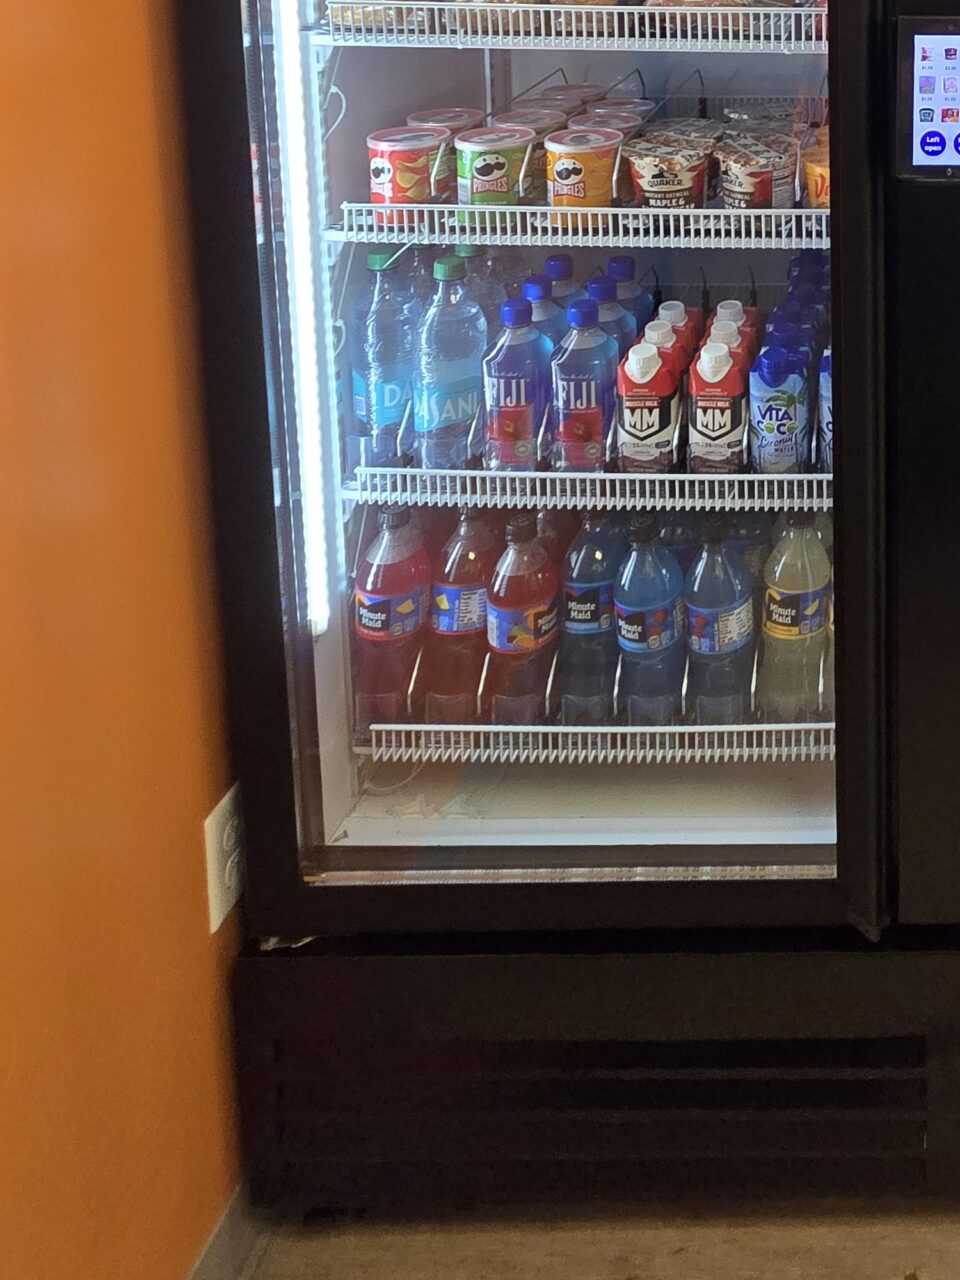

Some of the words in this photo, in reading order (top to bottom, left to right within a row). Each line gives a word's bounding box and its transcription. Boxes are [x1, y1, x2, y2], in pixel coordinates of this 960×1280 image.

[473, 177, 508, 193] PRINGLES
[647, 179, 684, 188] QUAKER
[487, 378, 527, 410] FIJI
[556, 380, 596, 410] FIJI
[757, 404, 793, 422] VITA
[624, 408, 660, 433] MM
[696, 408, 732, 433] MM
[757, 420, 799, 435] COCO
[567, 600, 596, 611] Minute
[769, 602, 797, 616] Minute
[359, 606, 387, 621] Minute
[570, 610, 591, 620] Maid
[772, 611, 792, 624] Maid
[361, 616, 382, 628] Maid
[618, 619, 643, 633] Minute
[621, 627, 639, 639] Maid
